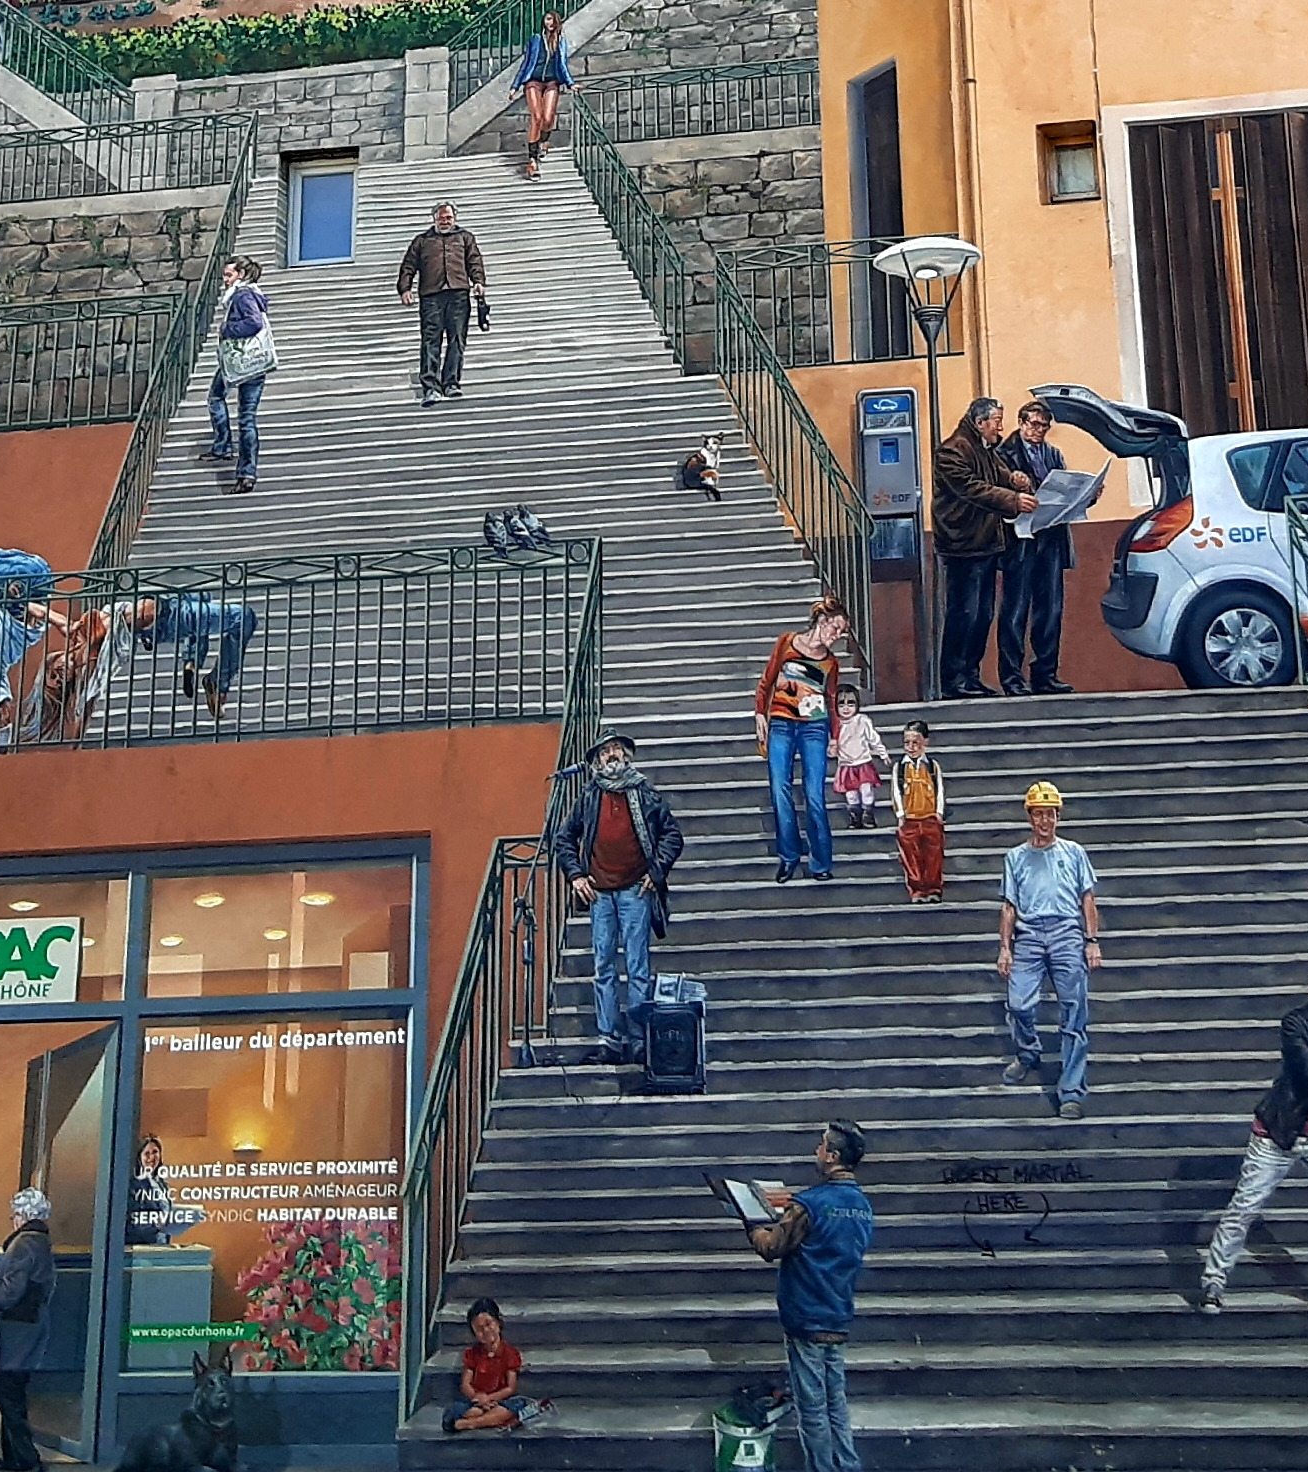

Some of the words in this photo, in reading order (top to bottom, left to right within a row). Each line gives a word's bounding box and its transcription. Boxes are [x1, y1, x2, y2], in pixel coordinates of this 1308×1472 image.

[169, 1033, 243, 1052] bailleur
[249, 1031, 273, 1049] du
[279, 1027, 405, 1051] département
[157, 1161, 222, 1179] QUALITÉ
[225, 1163, 247, 1177] DE
[249, 1162, 313, 1177] SERVICE
[316, 1158, 399, 1175] PROXIMITÉ
[180, 1184, 300, 1201] CONSTRUCTEUR
[302, 1181, 398, 1199] AMÉNAGEUR
[977, 1192, 1029, 1213] HERE
[131, 1210, 195, 1225] SERVICE
[198, 1208, 254, 1223] SYNDIC
[256, 1208, 323, 1222] HABITAT
[324, 1206, 399, 1221] DURABLE
